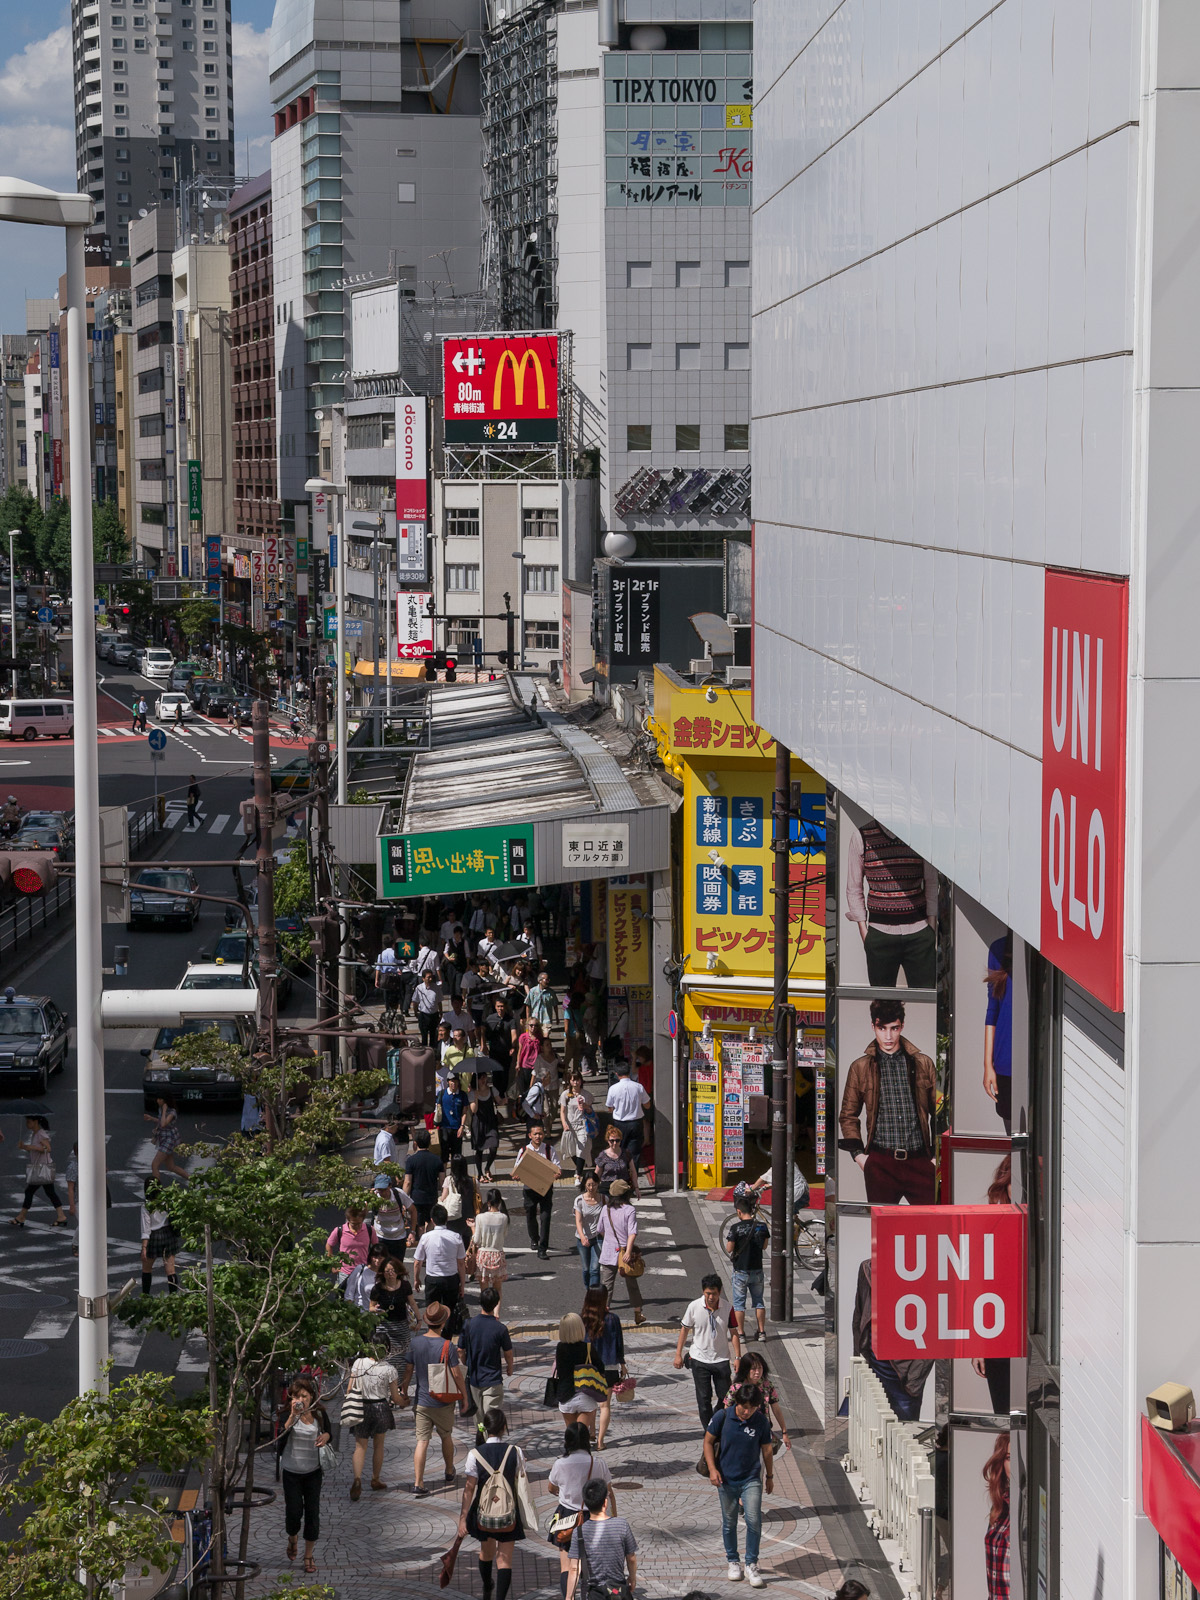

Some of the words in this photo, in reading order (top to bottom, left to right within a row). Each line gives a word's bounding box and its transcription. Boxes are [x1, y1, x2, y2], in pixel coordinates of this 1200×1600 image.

[613, 79, 655, 103] TIP.X
[659, 79, 716, 103] TOKYO
[453, 402, 485, 414] 青梅街道
[458, 382, 481, 401] 80m
[405, 404, 416, 470] docomo
[497, 422, 518, 440] 24
[209, 542, 220, 599] カラケ
[612, 579, 626, 591] 3F
[632, 579, 646, 591] 2F
[646, 579, 659, 591] 1F
[614, 593, 624, 653] ブランド買取
[640, 593, 651, 653] ブランド販売
[1051, 626, 1104, 772] UNI
[703, 797, 722, 843] 新幹線
[738, 800, 757, 841] きっぷ
[390, 846, 404, 876] 新宿
[413, 847, 500, 875] 思い出横丁
[512, 846, 524, 876] 西口
[568, 840, 624, 852] 東口近道
[1048, 787, 1106, 941] QLO
[703, 866, 722, 912] 映画券
[738, 870, 757, 910] 委託
[614, 893, 628, 981] ビックチケット
[894, 1233, 994, 1281] UNI
[894, 1292, 1006, 1350] QLO
